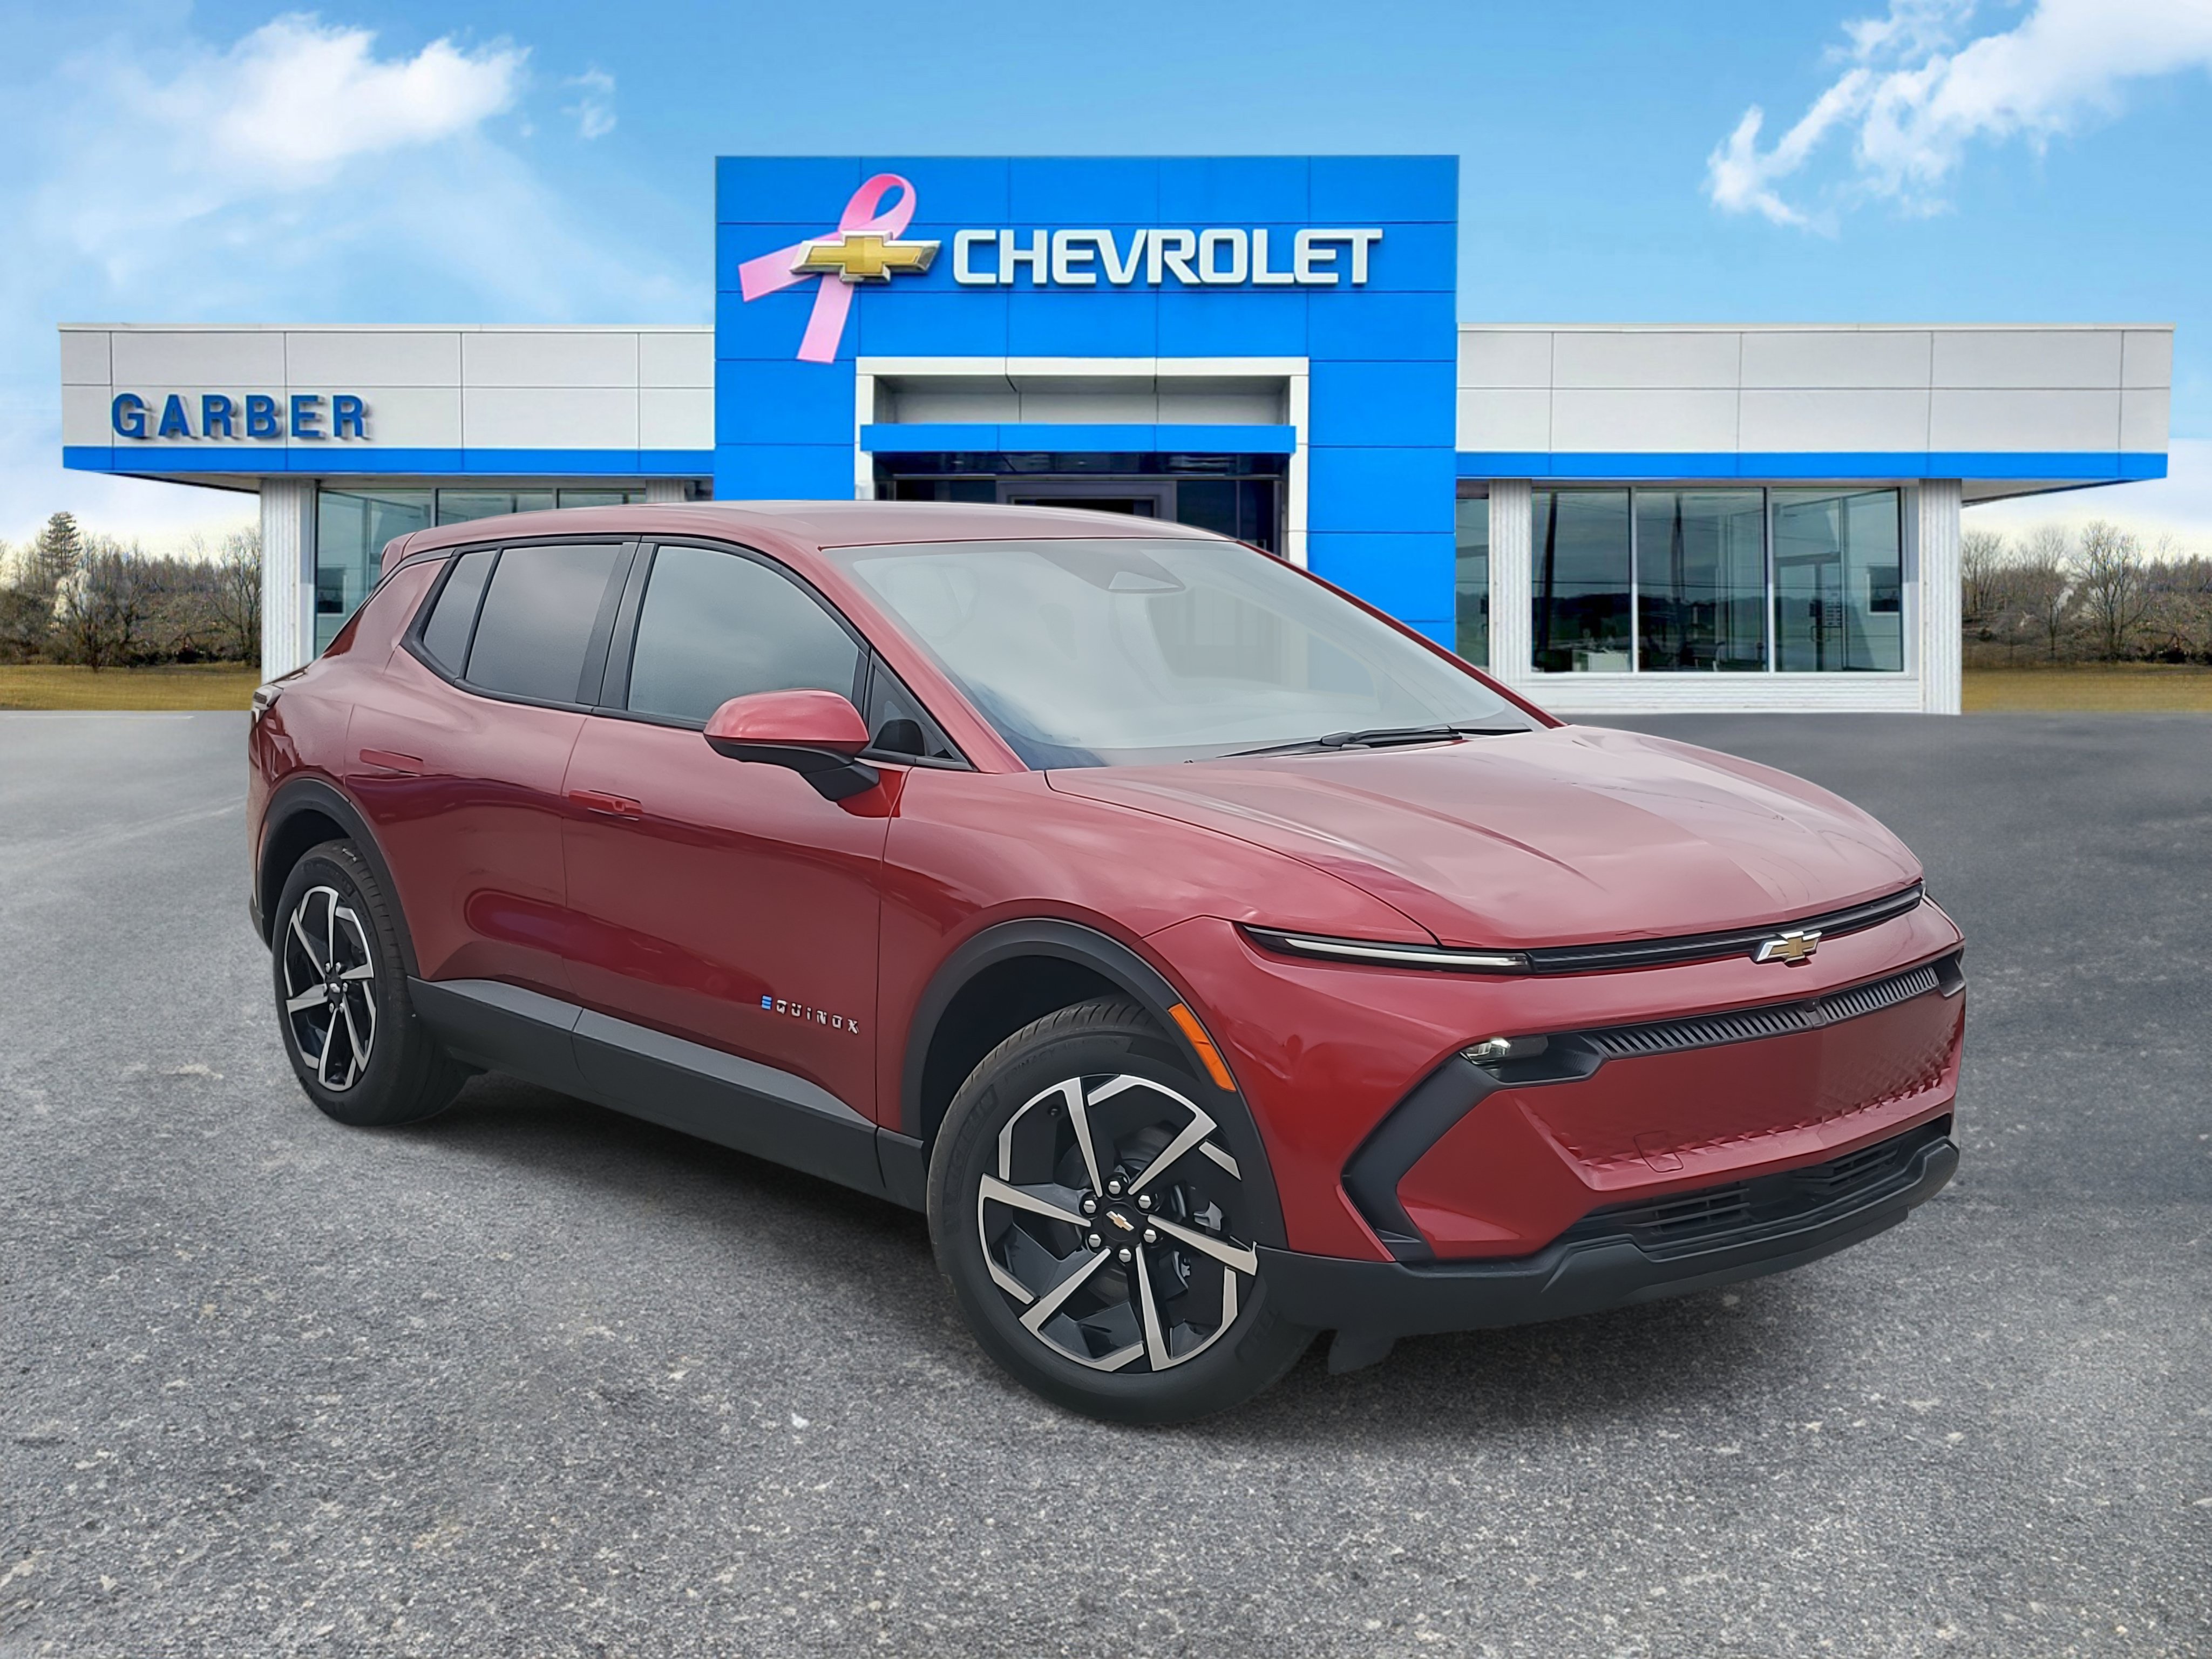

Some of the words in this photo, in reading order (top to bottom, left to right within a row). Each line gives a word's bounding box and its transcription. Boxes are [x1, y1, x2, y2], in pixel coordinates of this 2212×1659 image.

[953, 228, 1383, 285] CHEVROLET
[111, 393, 368, 438] GARBER
[761, 995, 859, 1035] EQUINOX
